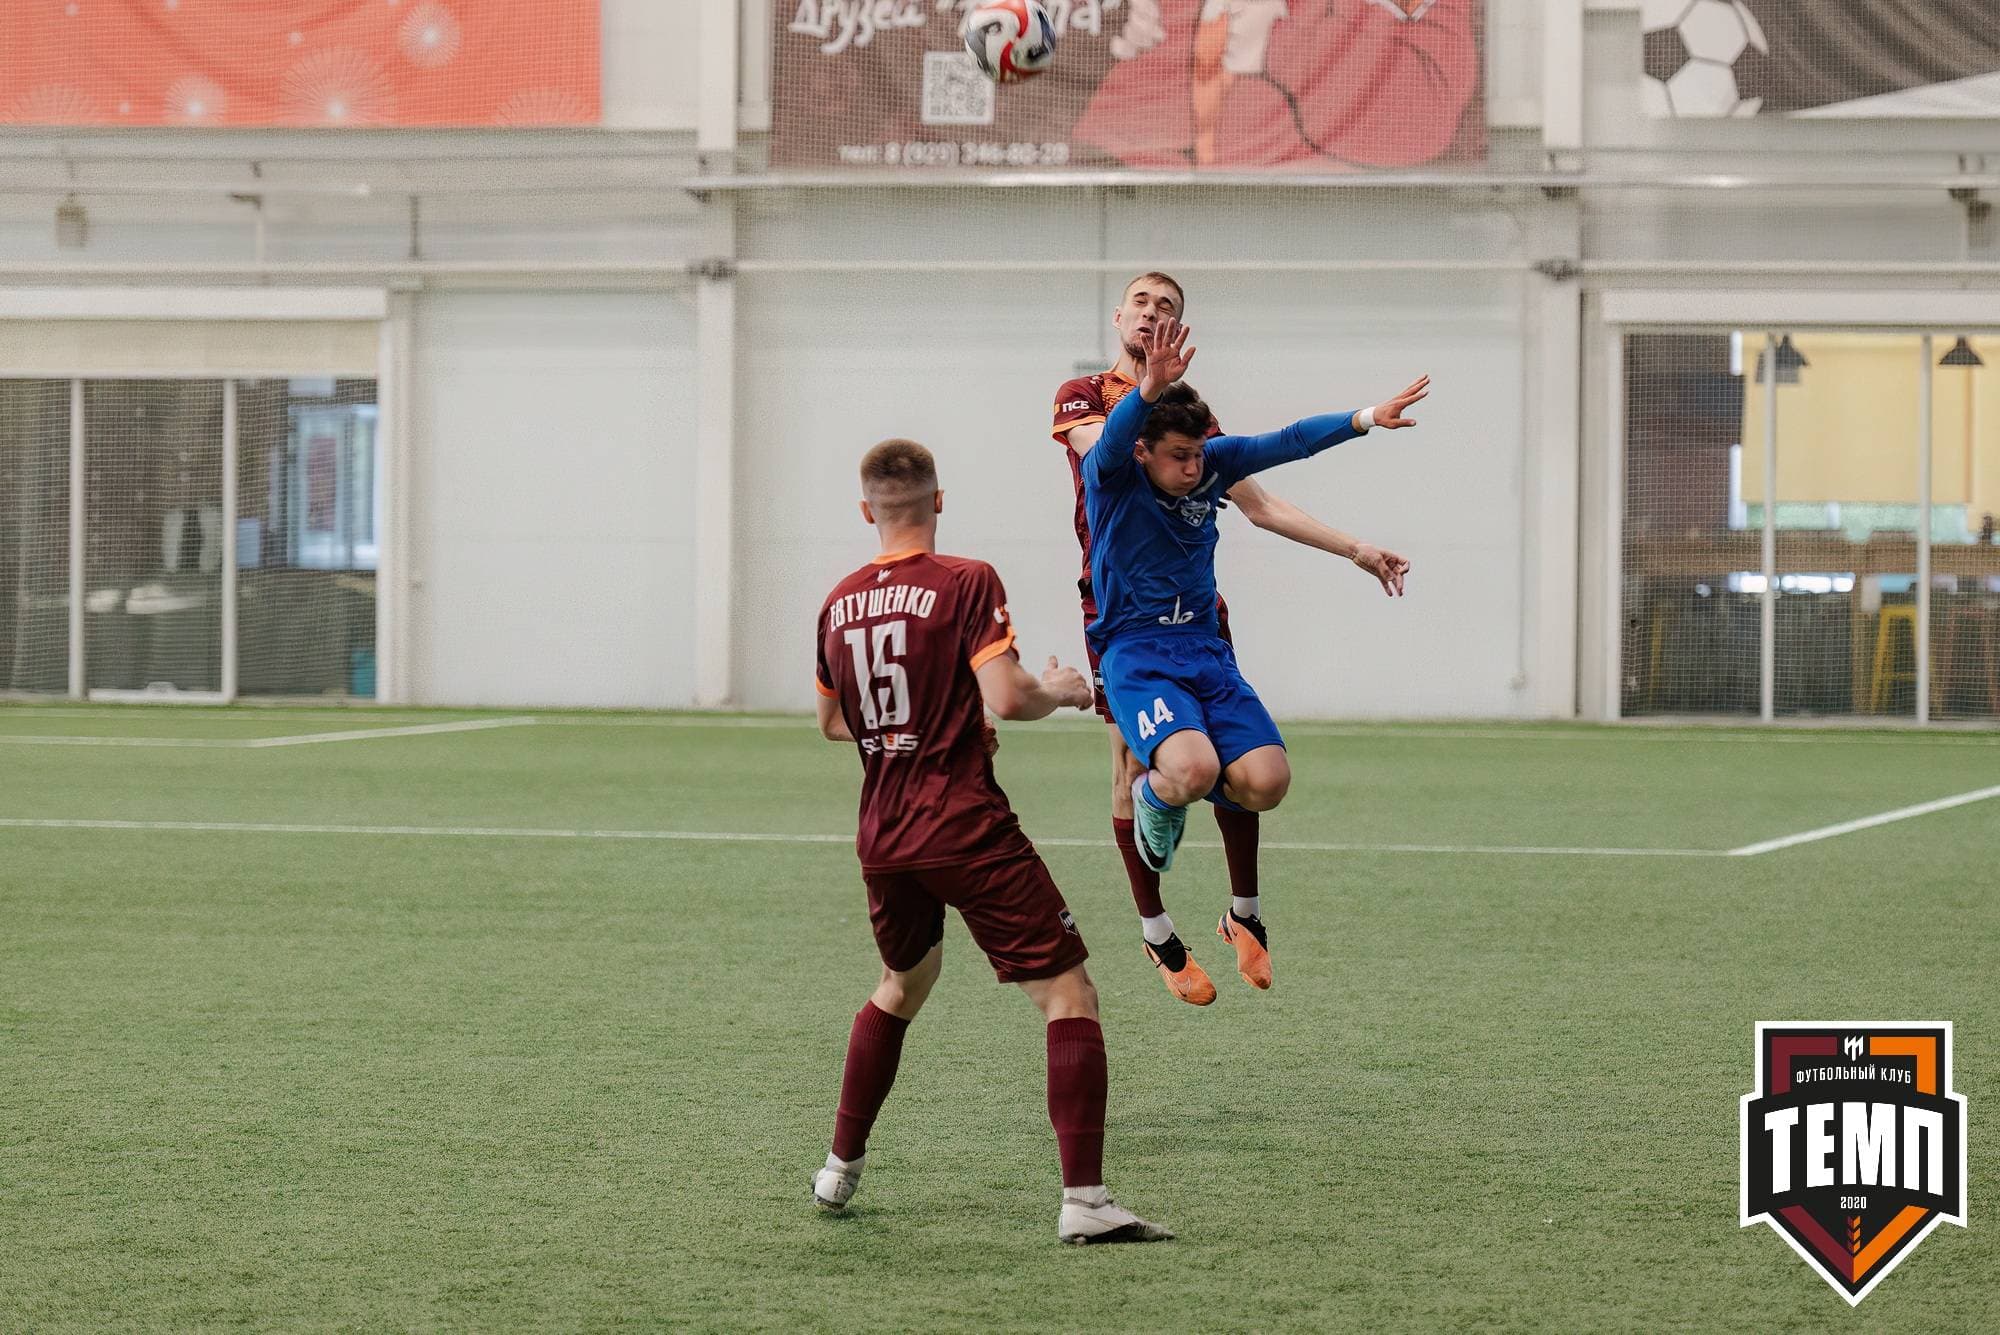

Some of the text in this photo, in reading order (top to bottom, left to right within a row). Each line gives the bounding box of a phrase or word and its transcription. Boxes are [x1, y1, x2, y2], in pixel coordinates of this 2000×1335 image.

[1062, 400, 1090, 413] ПСБ
[830, 584, 937, 632] ЕВТУШЕНКО
[843, 619, 910, 730] 15
[1137, 696, 1175, 741] 44
